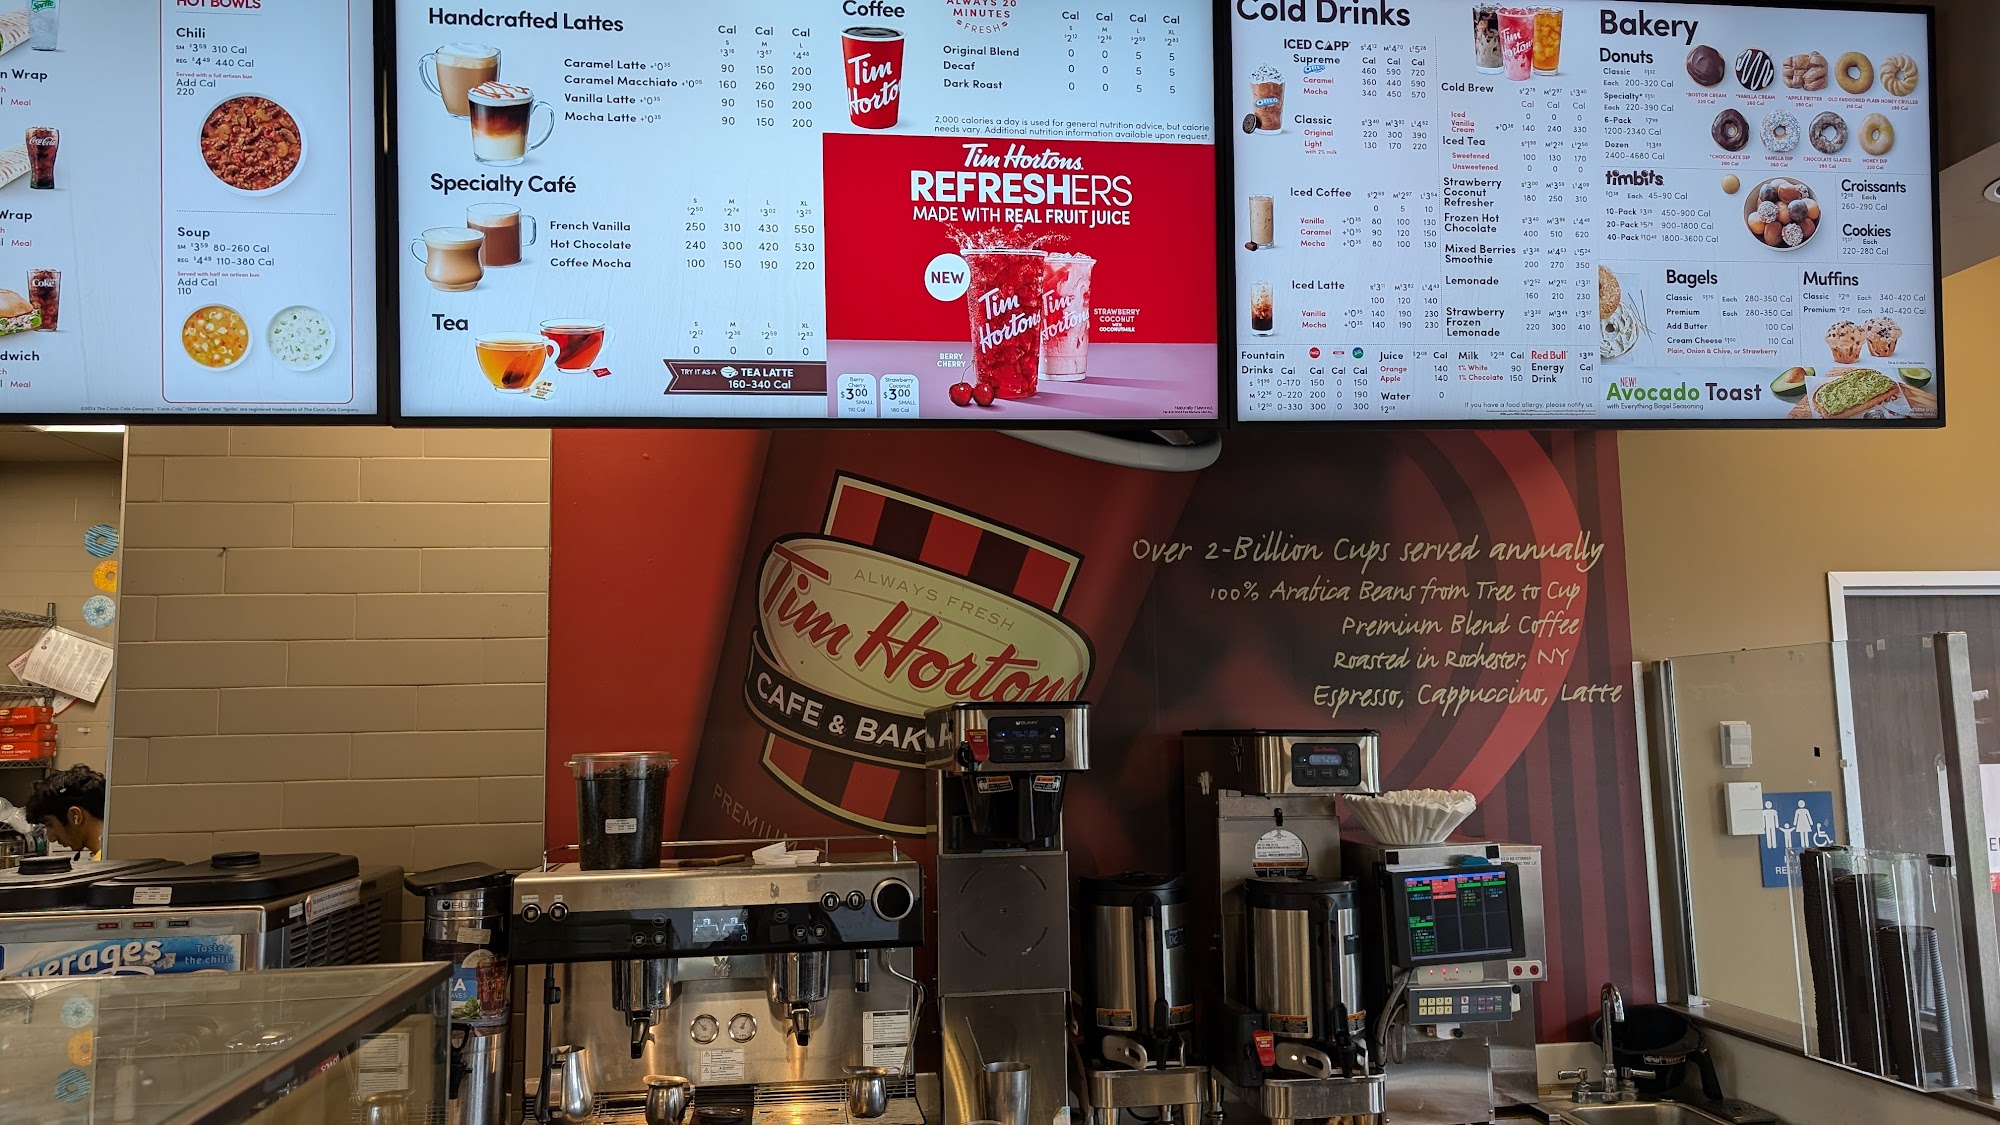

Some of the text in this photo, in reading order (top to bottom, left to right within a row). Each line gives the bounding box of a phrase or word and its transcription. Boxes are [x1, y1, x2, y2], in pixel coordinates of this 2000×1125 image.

[842, 0, 906, 18] Coffee
[952, 9, 1011, 19] MINUTES
[1236, 0, 1411, 27] Cold Drinks
[429, 7, 624, 32] Handcrafted Lattes
[176, 27, 206, 39] Chili
[1600, 9, 1699, 46] Bakery
[211, 45, 248, 54] 310 Cal
[943, 45, 1020, 58] Original Blend
[1599, 47, 1654, 64] Donuts
[215, 58, 254, 68] 440 Cal
[564, 58, 647, 70] Caramel Latte
[943, 60, 976, 71] Decaf
[1293, 54, 1341, 66] Supreme
[11, 68, 48, 83] Wrap
[564, 74, 678, 87] Caramel Macchiato
[1302, 76, 1334, 84] Caramel
[176, 79, 216, 88] Add Cal
[943, 78, 1003, 90] Dark Roast
[1441, 82, 1494, 93] Cold Brew
[176, 87, 195, 96] 220
[564, 93, 636, 104] Vanilla Latte
[564, 111, 637, 123] Mocha Latte
[1294, 114, 1333, 125] Classic
[1604, 116, 1632, 124] 6-Pack
[934, 115, 959, 127] 2,000
[960, 115, 994, 128] calories
[1003, 117, 1019, 128] day
[1030, 118, 1050, 127] used
[1051, 118, 1064, 127] for
[1066, 119, 1098, 129] general
[1099, 121, 1134, 129] nutrition
[1135, 121, 1165, 133] advice,
[1166, 122, 1181, 131] but
[1182, 123, 1210, 132] calorie
[1303, 128, 1334, 138] Original
[1604, 126, 1662, 136] 1200-2340 Cal
[1304, 140, 1323, 149] Light
[1604, 140, 1629, 149] Dozen
[961, 142, 1084, 171] Tim Hortons
[1451, 151, 1490, 160] Sweetened
[1452, 163, 1499, 171] Unsweetened
[1605, 169, 1665, 187] timbits
[430, 172, 577, 197] Specialty Café
[909, 170, 1133, 207] REFRESHERS
[1841, 179, 1907, 194] Croissants
[913, 207, 1131, 228] MADE WITH REAL FRUIT JUICE
[550, 220, 631, 231] French Vanilla
[1842, 224, 1892, 238] Cookies
[177, 226, 211, 241] Soup
[213, 243, 270, 253] 80-260 Cal
[550, 239, 632, 250] Hot Chocolate
[216, 257, 275, 267] 110-380 Cal
[550, 257, 631, 268] Coffee Mocha
[931, 272, 965, 285] NEW
[1445, 275, 1499, 285] Lemonade
[1666, 269, 1718, 289] Bagels
[1803, 270, 1859, 287] Muffins
[1093, 308, 1140, 316] STRAWBERRY
[431, 313, 469, 331] Tea
[1099, 315, 1135, 323] COCONUT
[1666, 322, 1708, 331] Add Butter
[1666, 336, 1723, 344] Cream Cheese
[939, 352, 964, 360] BERRY
[1241, 350, 1285, 360] Fountain
[1378, 351, 1404, 363] Juice
[1458, 351, 1479, 360] Milk
[740, 367, 794, 378] TEA LATTE
[1380, 365, 1408, 375] Orange
[1531, 362, 1565, 377] Energy
[1380, 375, 1401, 384] Apple
[1531, 374, 1557, 383] Drink
[1620, 376, 1637, 388] NEW!
[728, 379, 793, 391] 160-340 Cal
[1605, 380, 1762, 402] Avocado Toast
[1380, 391, 1411, 401] Water
[1505, 401, 1520, 409] food
[1546, 402, 1566, 410] please
[1132, 530, 1606, 575] Over 2-Billion Cups served annually
[1210, 575, 1581, 610] 100% Arabica Beans from Tree to Cup
[853, 568, 1016, 633] ALWAYS FRESH
[762, 542, 1084, 702] Tim Hortons
[1341, 612, 1580, 638] Premium Blend Coffee
[1333, 648, 1569, 671] Roasted in Rochester, NY
[757, 672, 847, 735] CAFE &
[1313, 680, 1623, 719] Espresso, Cappuccino, Latte
[195, 943, 225, 952] Taste
[184, 954, 234, 965] the chill!
